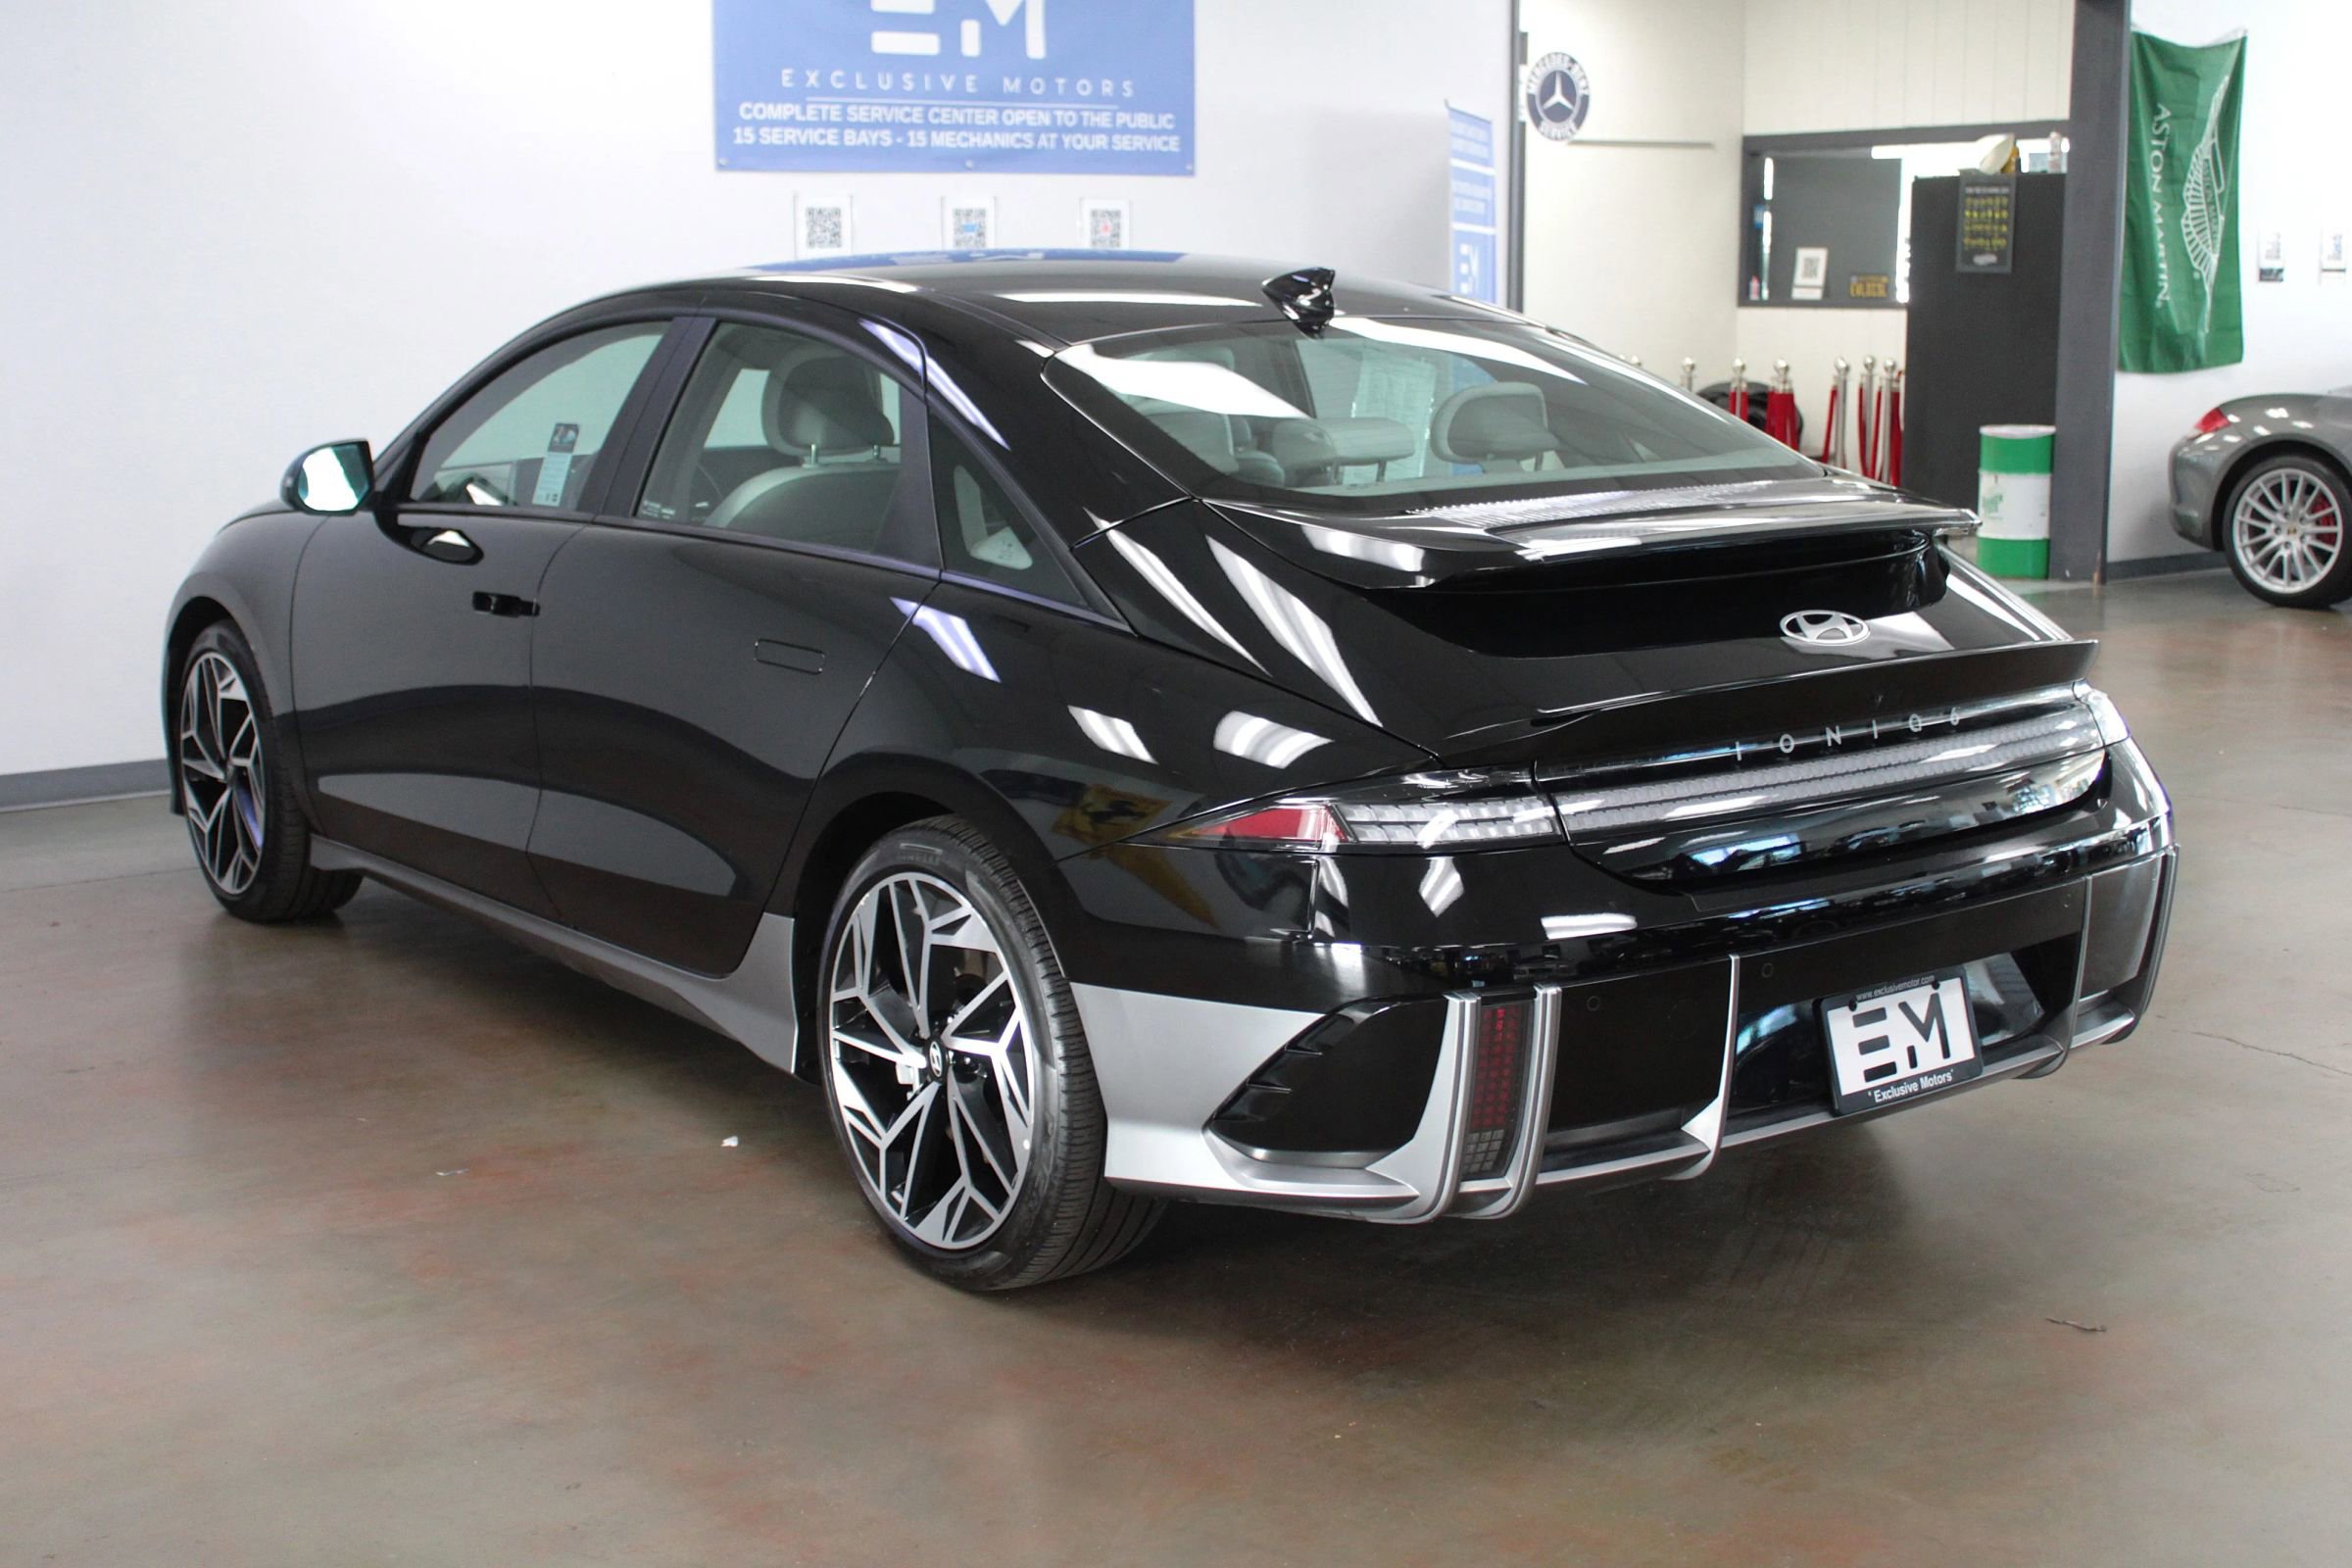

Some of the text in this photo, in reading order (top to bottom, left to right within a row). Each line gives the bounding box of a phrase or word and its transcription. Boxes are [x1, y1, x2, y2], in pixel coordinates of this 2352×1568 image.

[781, 68, 1134, 97] EXCLUSIVE MOTORS
[739, 102, 1175, 129] COMPLETE SERVICE CENTER OPEN TO THE PUBLIC
[733, 126, 756, 144] 15
[759, 126, 840, 146] SERVICE
[844, 128, 893, 146] BAYS
[907, 129, 926, 147] 15
[931, 129, 1034, 149] MECHANICS
[1037, 131, 1057, 148] AT
[1061, 132, 1109, 150] YOUR
[1111, 133, 1181, 152] SERVICE
[2150, 104, 2172, 193] ASTON
[1735, 707, 1960, 761] IONIQ 6
[1856, 975, 1936, 1001] www.exclusivemotor.com
[1852, 993, 1951, 1083] EM
[1873, 1072, 1953, 1103] Exclusive Motors
